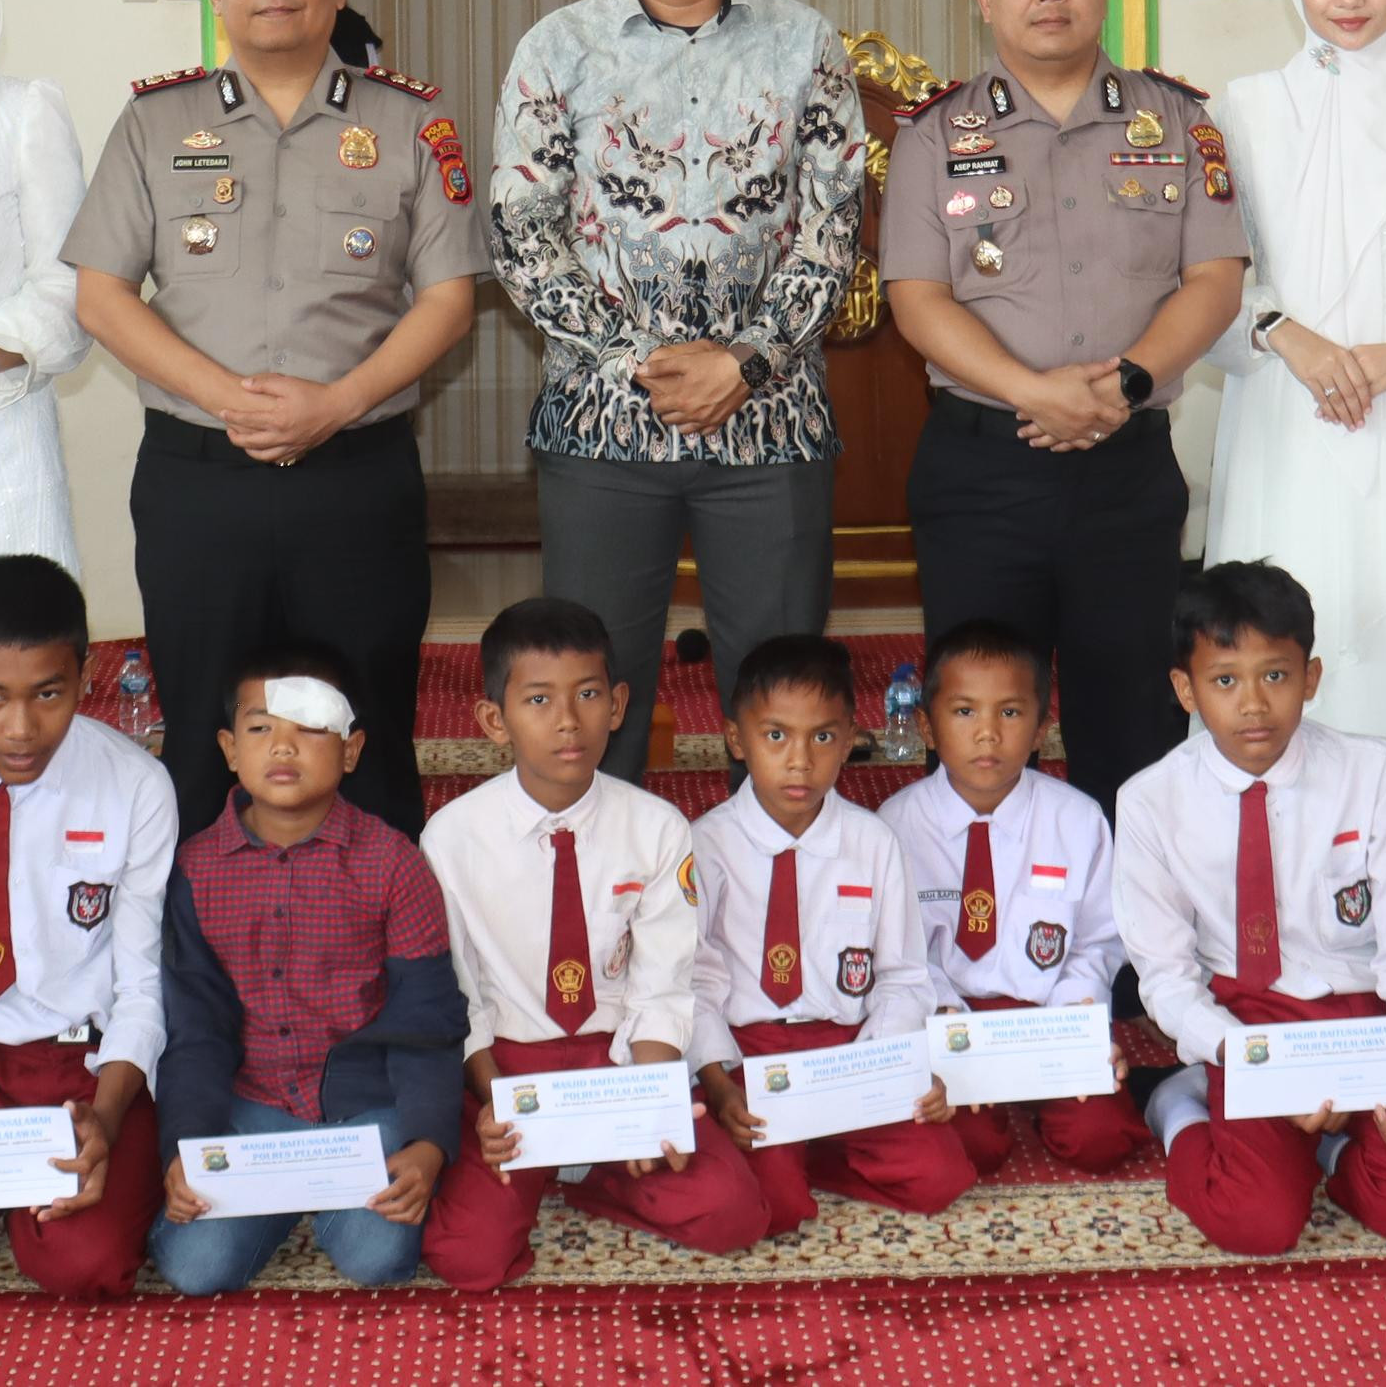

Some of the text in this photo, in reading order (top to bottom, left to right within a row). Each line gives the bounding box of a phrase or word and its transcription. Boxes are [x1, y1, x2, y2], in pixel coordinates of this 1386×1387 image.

[175, 159, 192, 167] JOHN
[953, 160, 999, 172] ASEP RAHMAT
[968, 918, 988, 933] SD
[773, 973, 789, 984] SD
[562, 993, 579, 1004] SD
[240, 1141, 277, 1152] MASJID
[253, 1150, 292, 1161] POLRES
